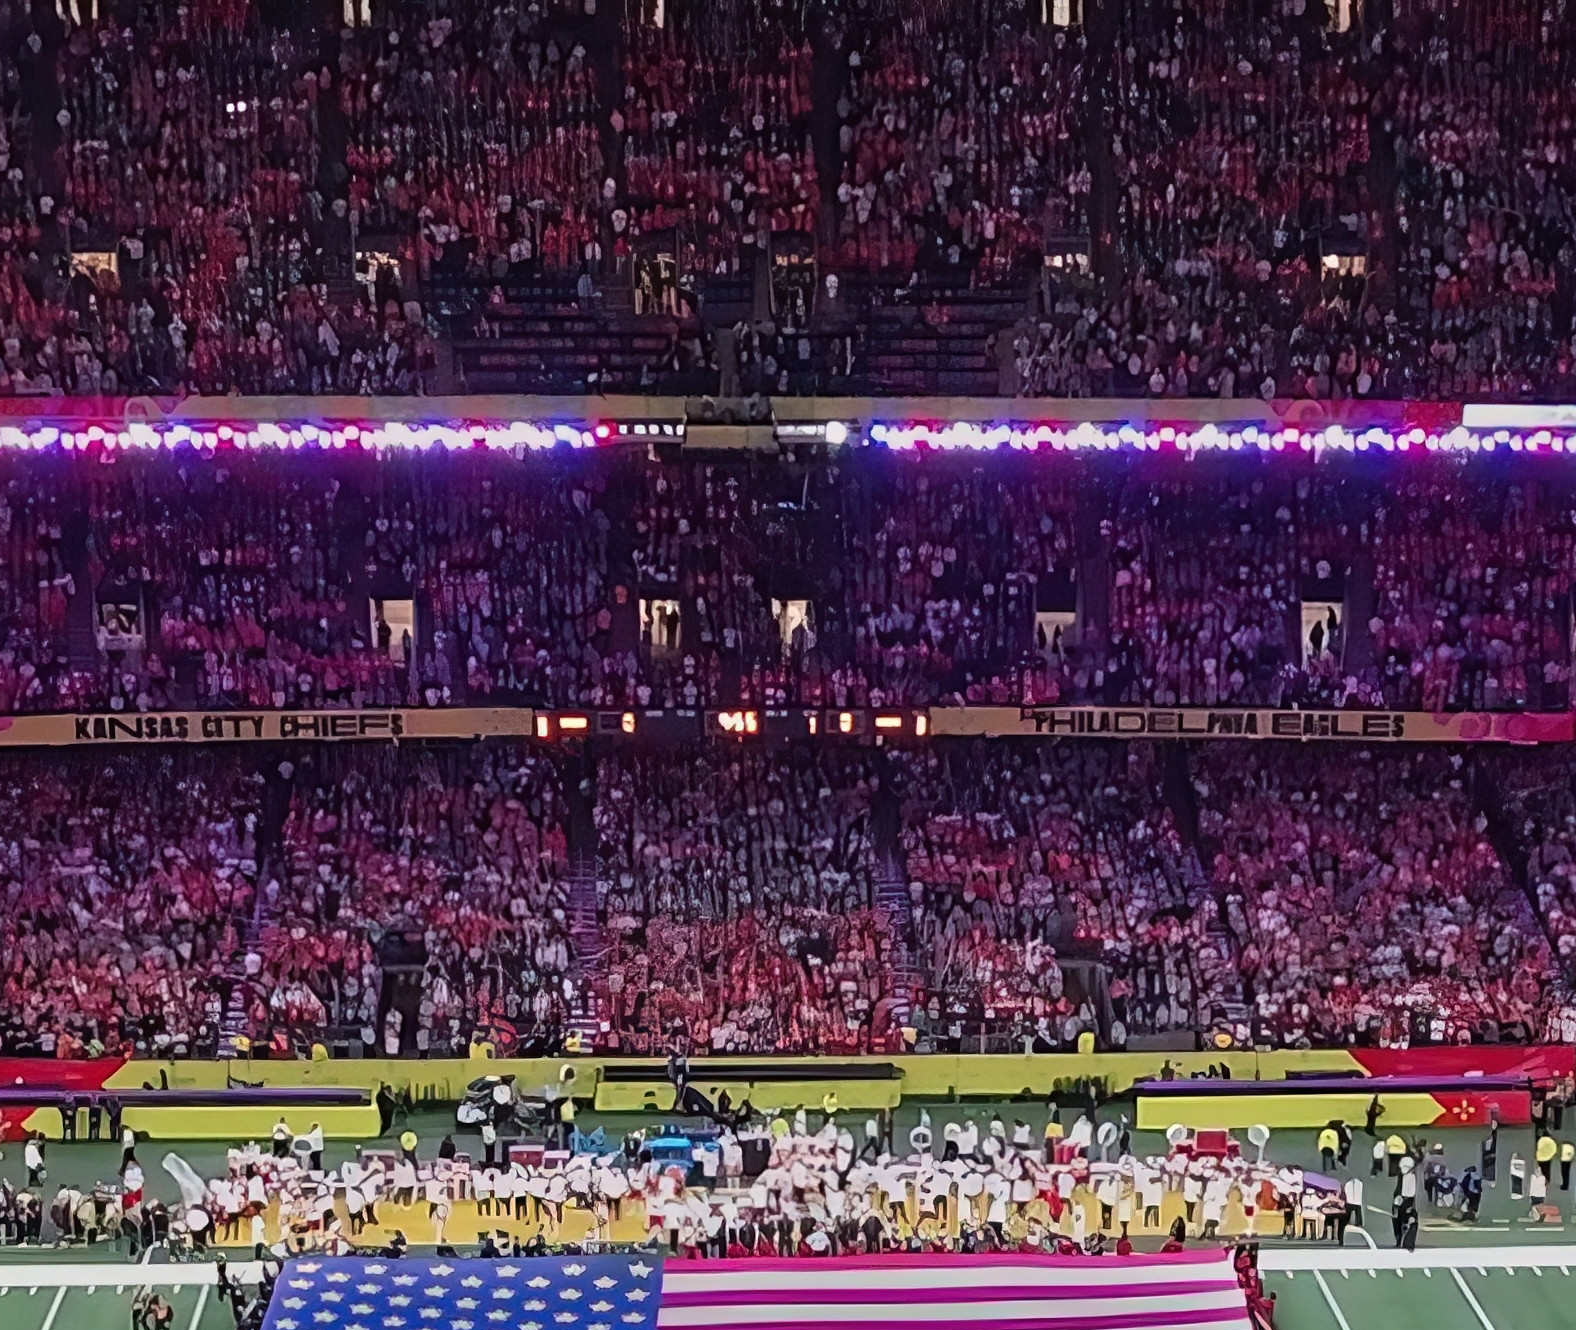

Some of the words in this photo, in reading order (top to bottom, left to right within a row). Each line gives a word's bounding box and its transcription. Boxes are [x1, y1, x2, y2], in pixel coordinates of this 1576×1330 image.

[74, 717, 188, 740] KANSAS
[202, 715, 265, 738] CITY
[280, 713, 403, 737] CHIEFS
